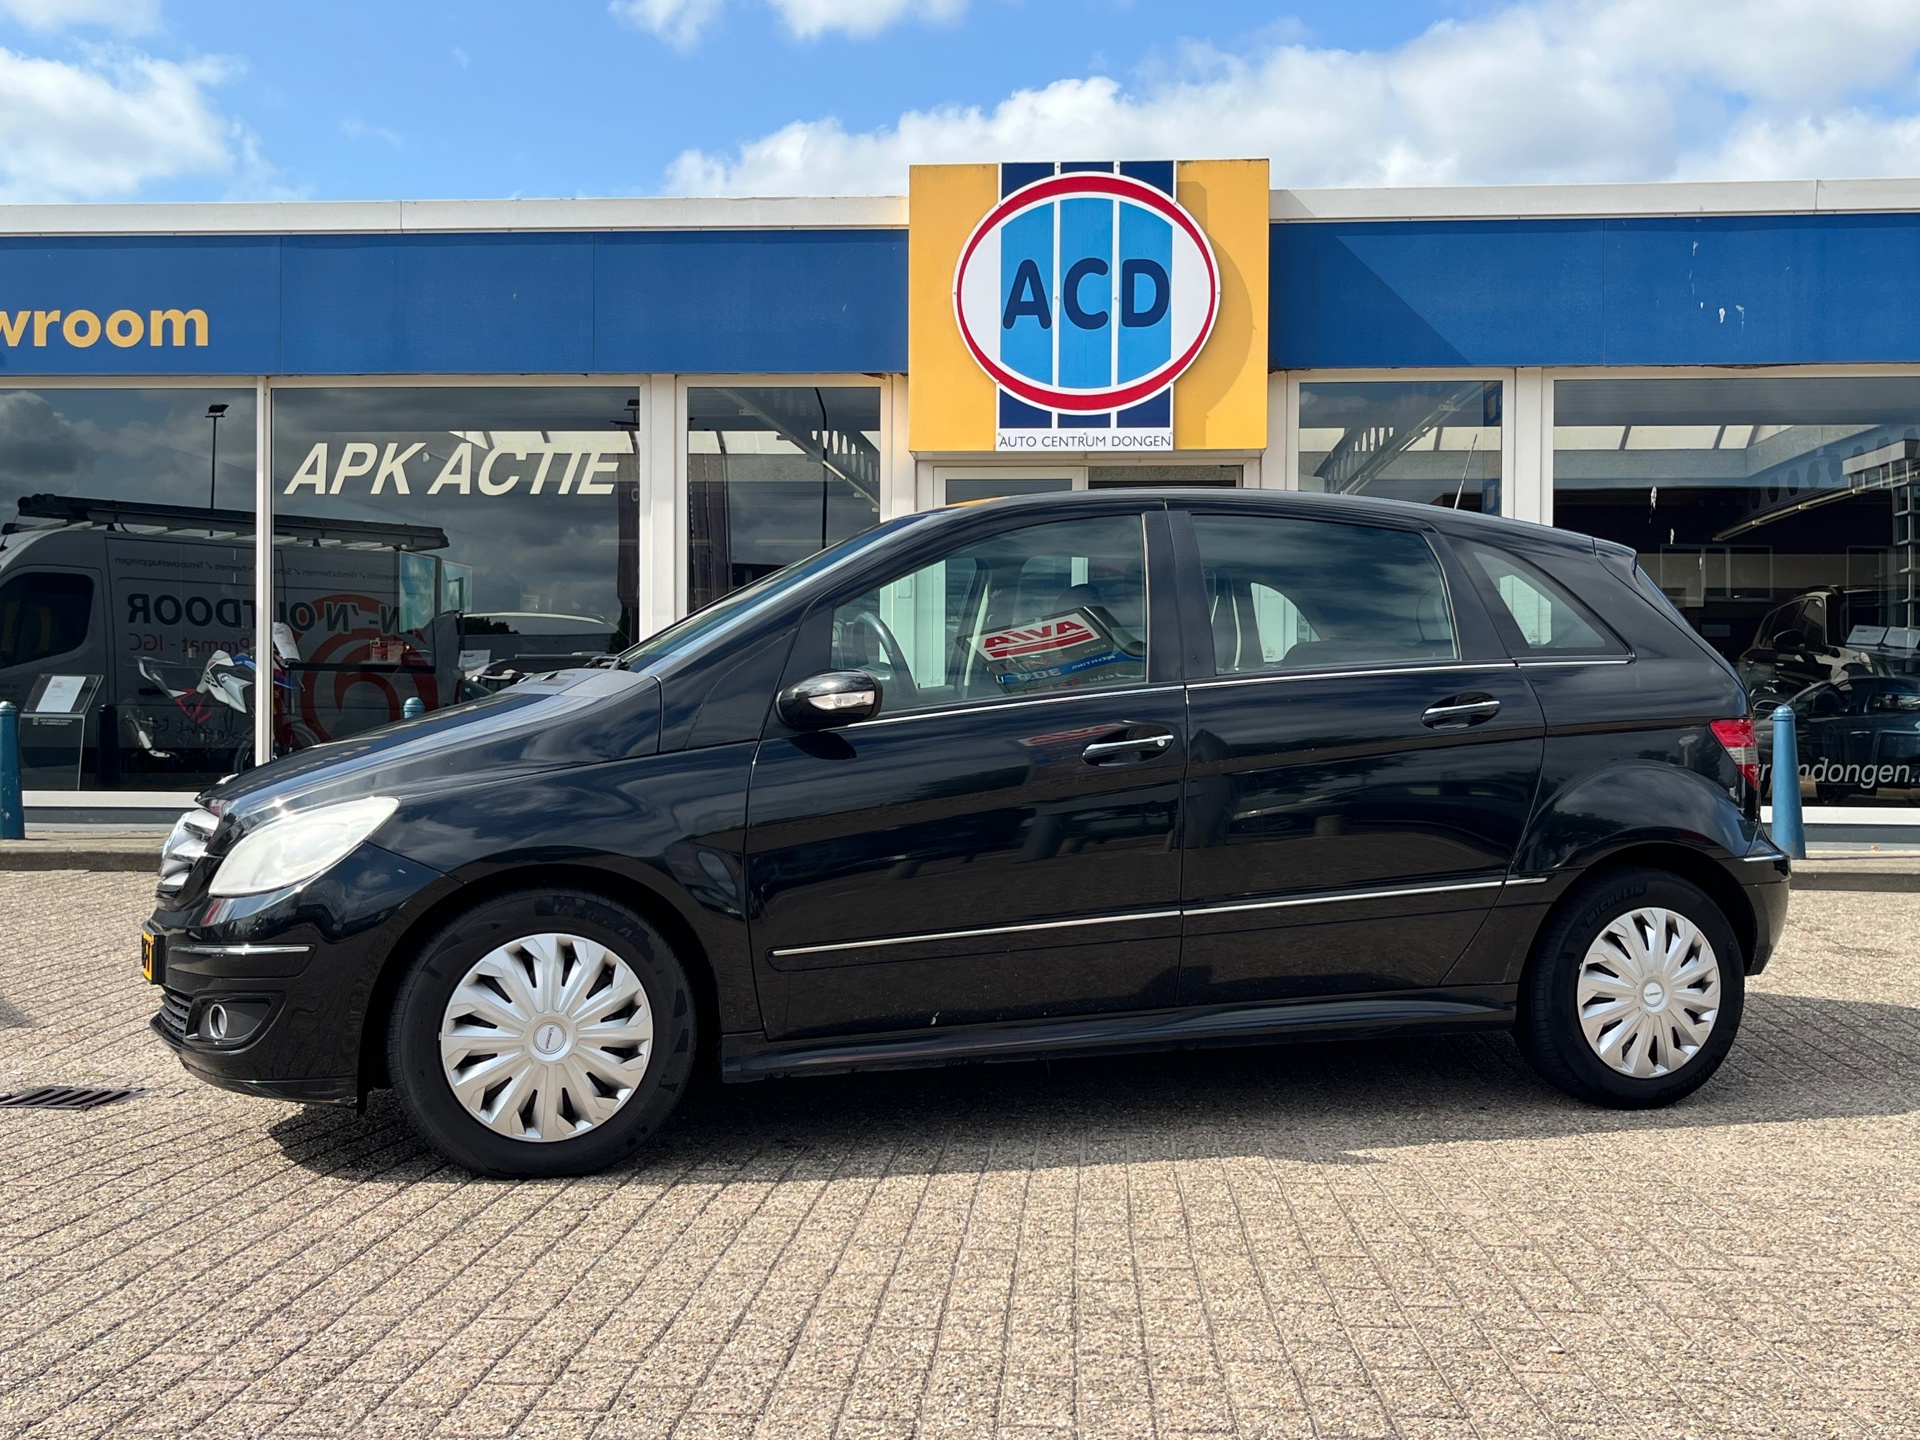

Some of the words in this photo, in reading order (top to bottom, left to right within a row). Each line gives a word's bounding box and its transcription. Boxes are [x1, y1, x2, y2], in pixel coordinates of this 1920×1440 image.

[1003, 257, 1170, 330] ACD
[999, 436, 1037, 448] AUTO
[1042, 436, 1106, 447] CENTRUM
[1112, 435, 1171, 447] DONGEN
[283, 442, 427, 495] APK
[427, 442, 621, 496] ACTIE
